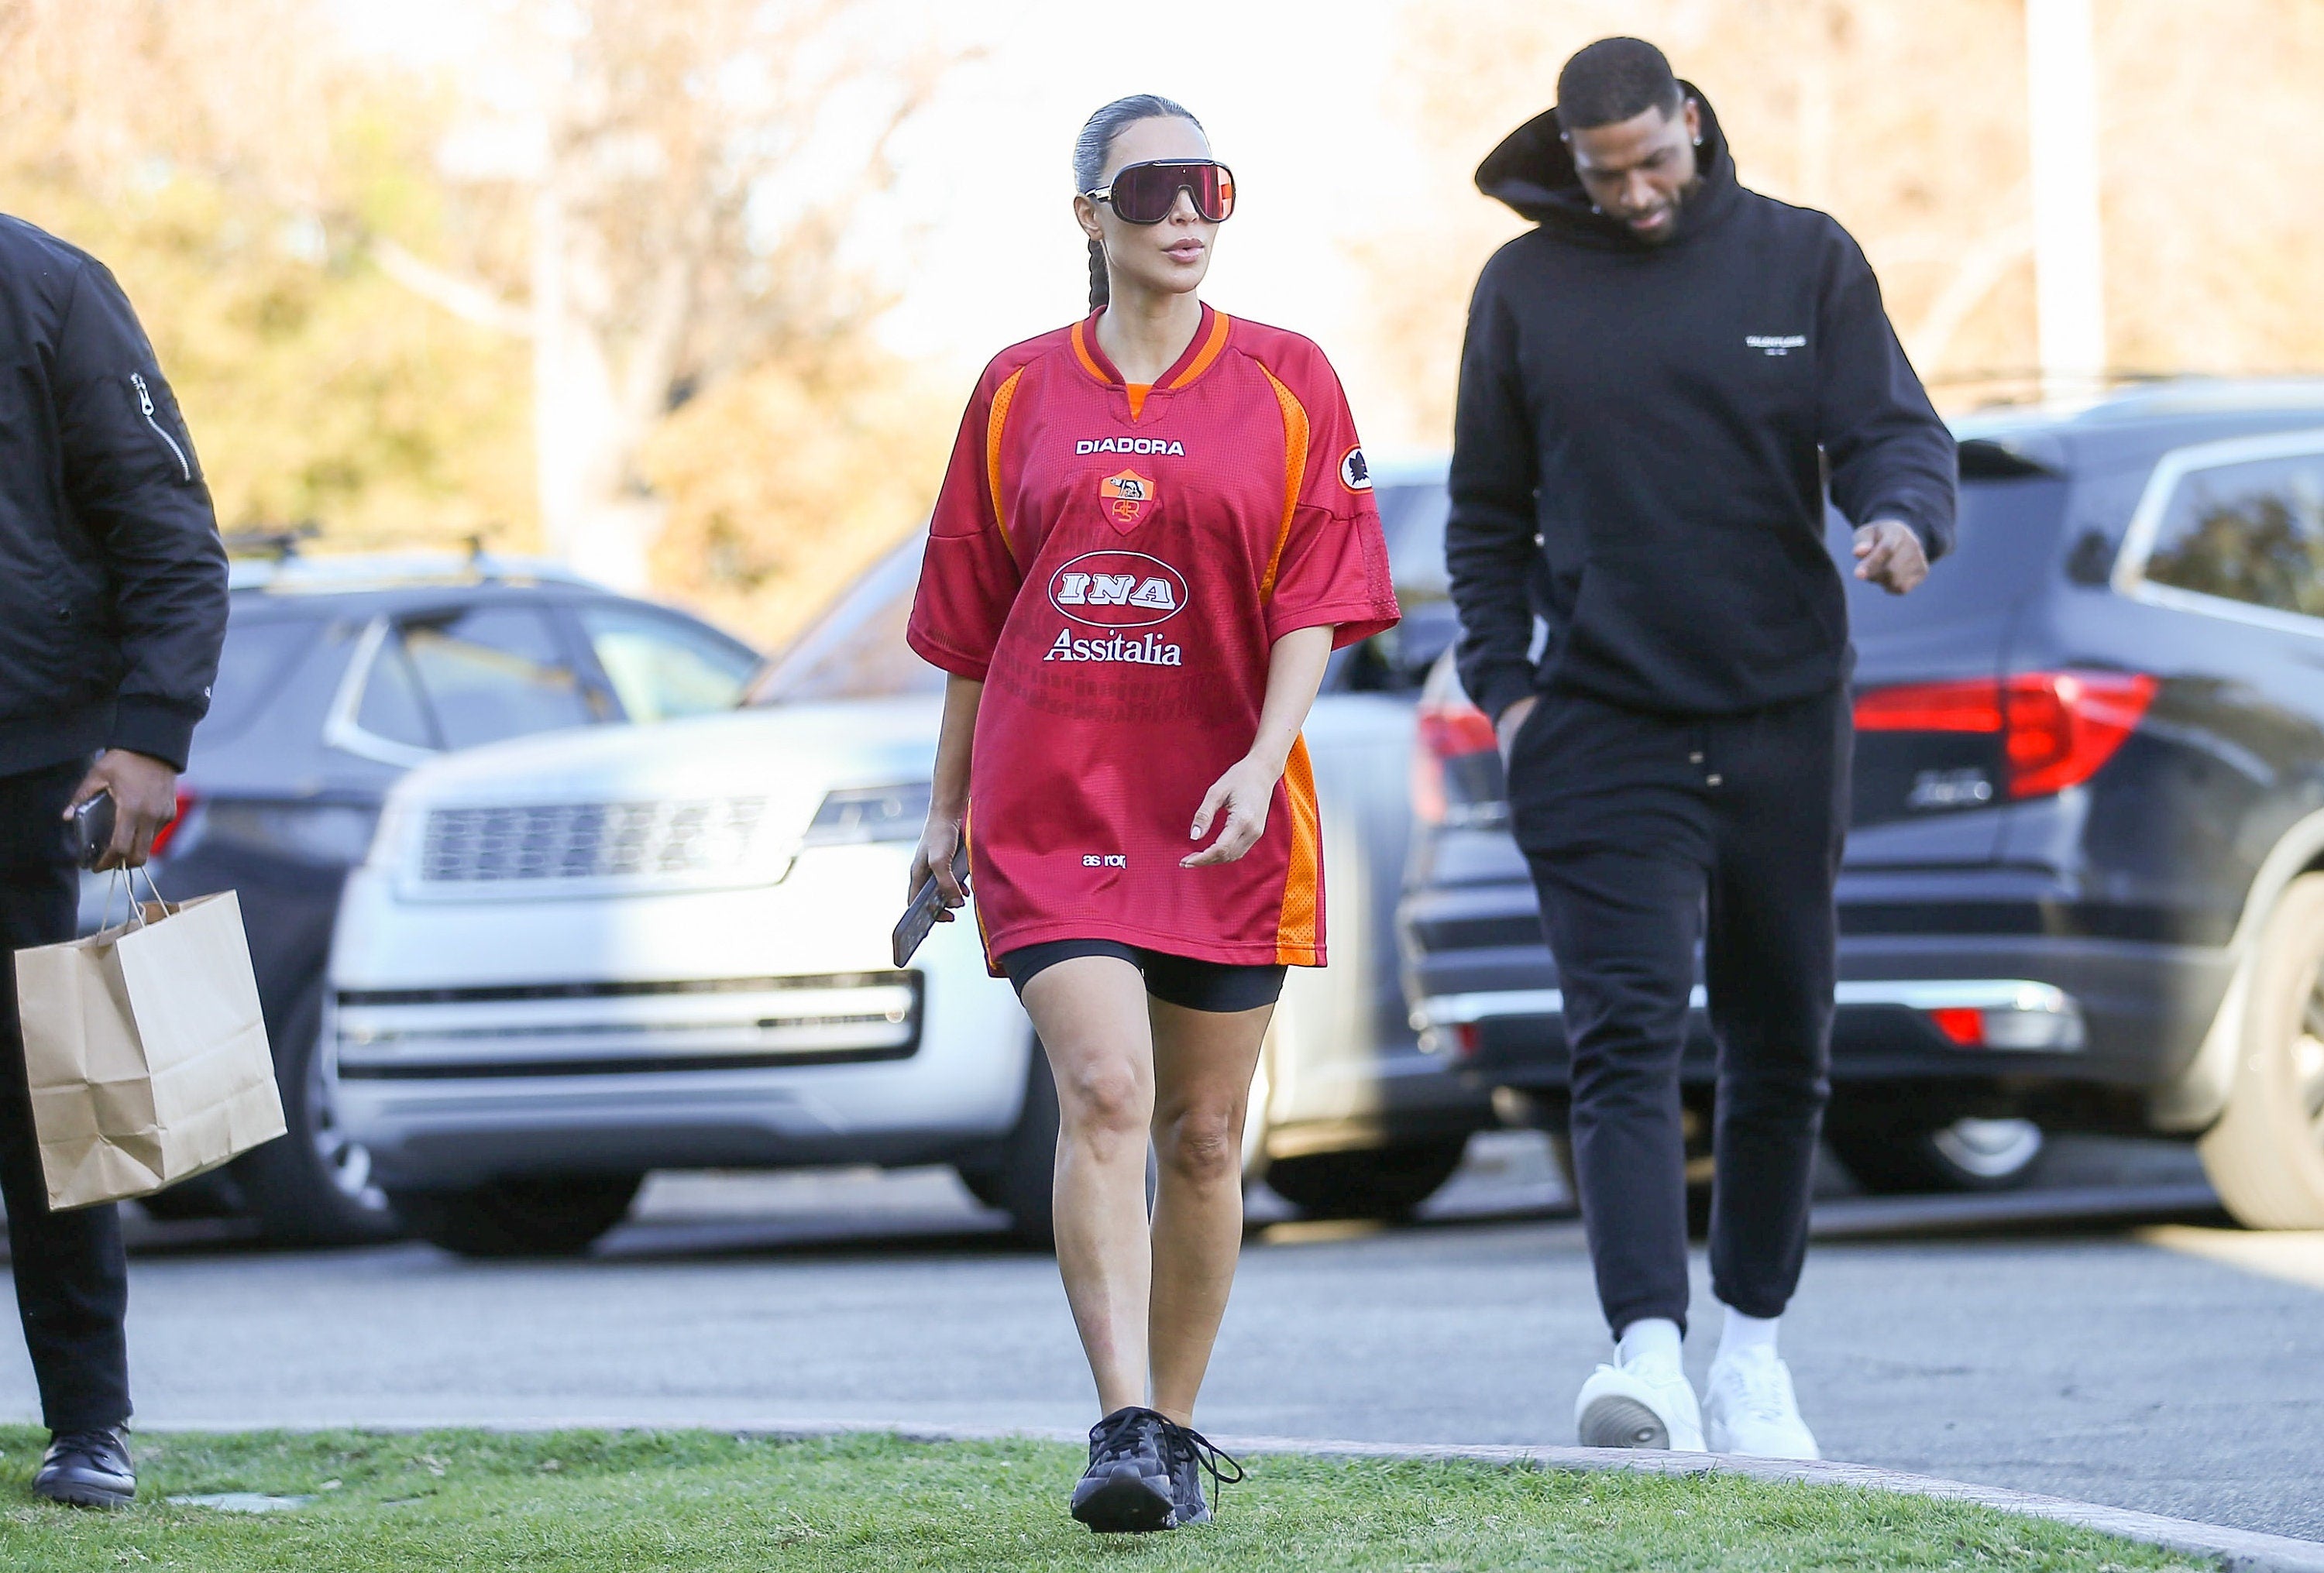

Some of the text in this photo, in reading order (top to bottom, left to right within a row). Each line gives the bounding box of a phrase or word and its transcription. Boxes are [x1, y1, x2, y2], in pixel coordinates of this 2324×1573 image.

[1075, 437, 1185, 456] DIADORA
[1057, 572, 1177, 610] INA
[1043, 628, 1182, 666] Assitalia
[1082, 854, 1101, 867] as
